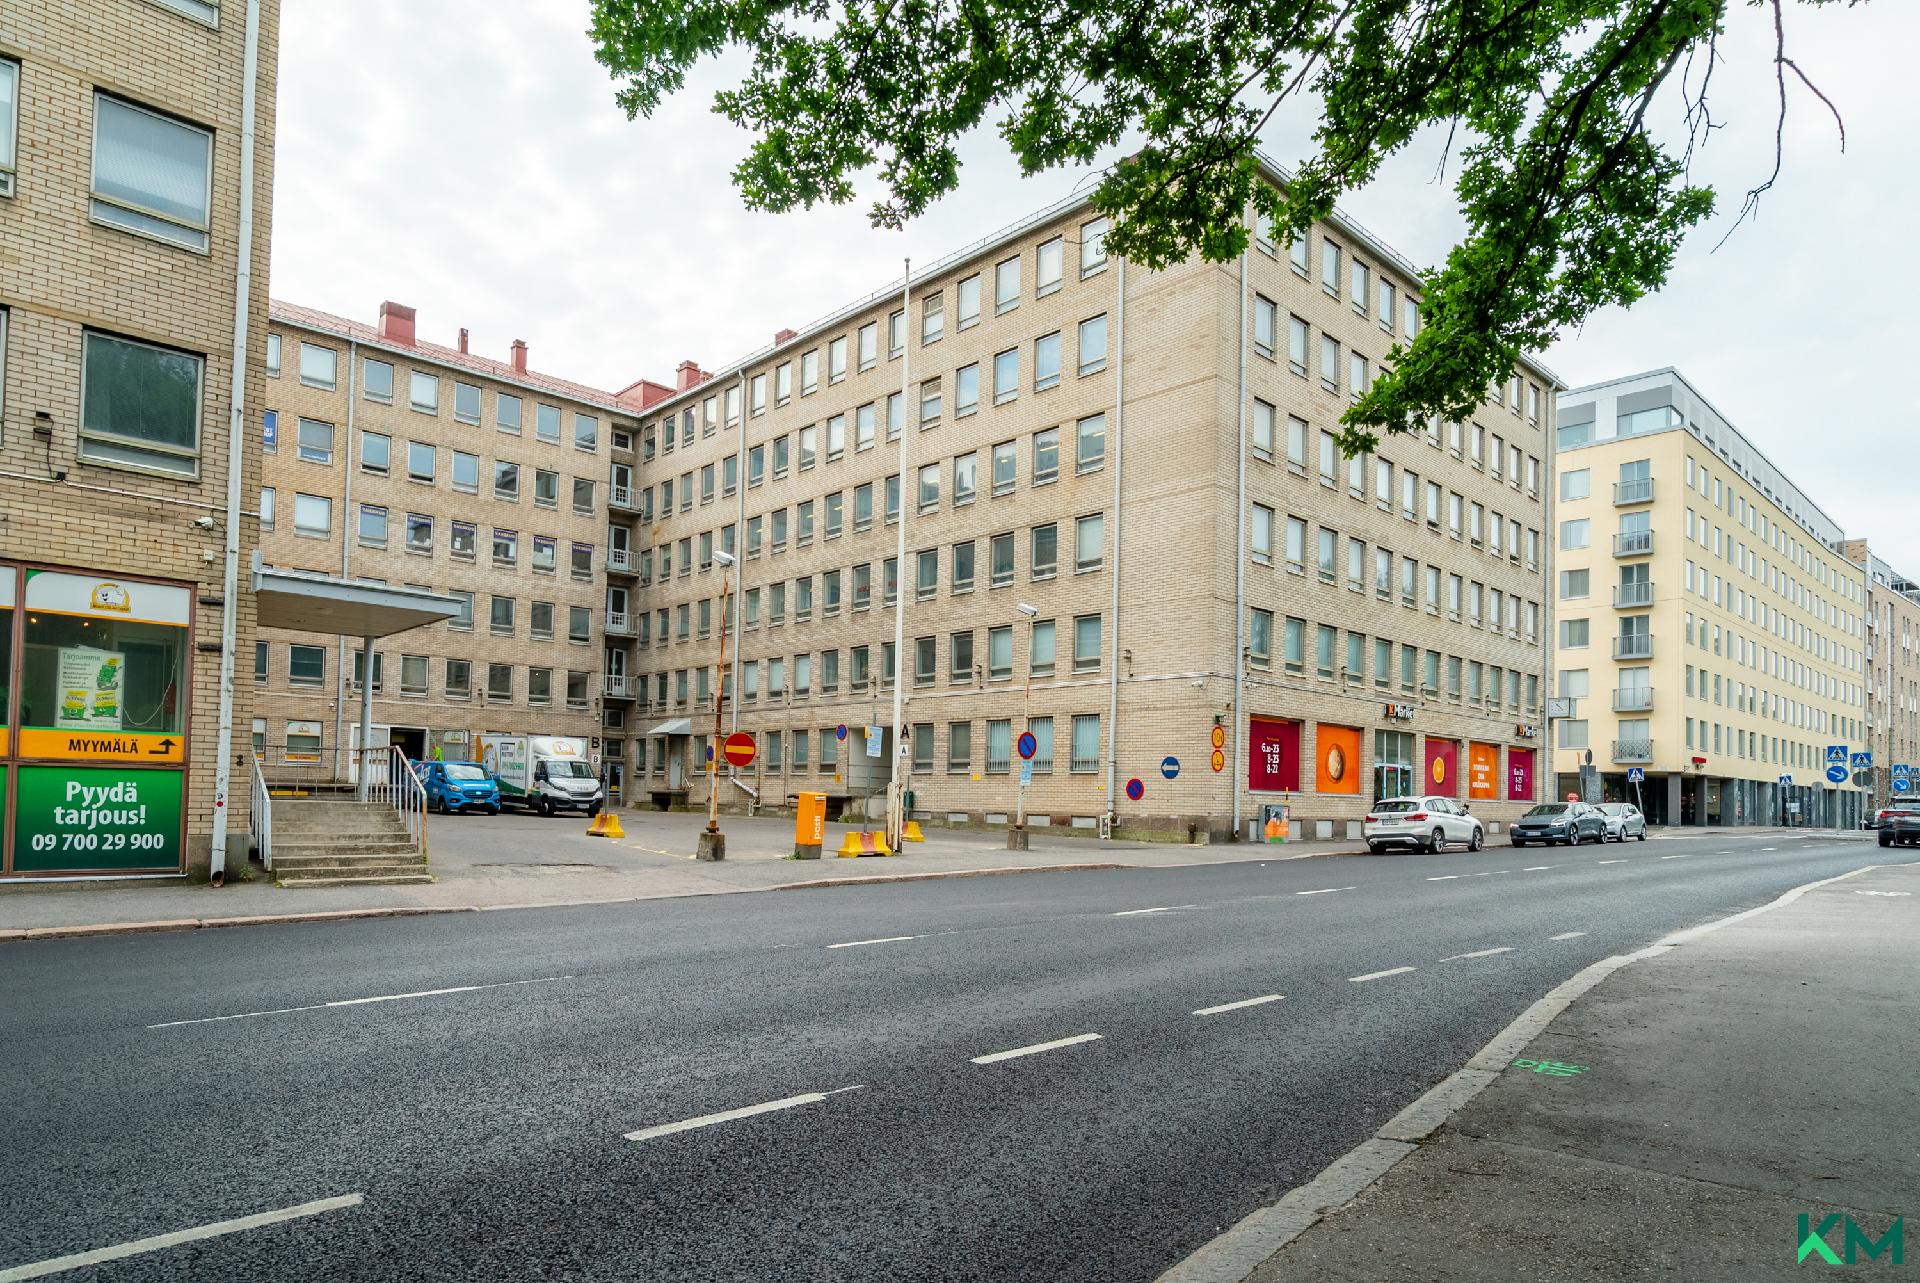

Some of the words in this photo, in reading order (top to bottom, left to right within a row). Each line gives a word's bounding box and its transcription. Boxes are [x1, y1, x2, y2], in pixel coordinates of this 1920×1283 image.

[901, 724, 910, 739] A
[68, 738, 139, 754] MYYMÄLÄ
[592, 736, 600, 748] B
[593, 755, 599, 763] B
[66, 781, 137, 808] Pyydä
[54, 804, 146, 830] tarjous!
[814, 815, 822, 840] posti
[31, 833, 57, 851] 09
[62, 833, 98, 851] 700
[101, 833, 126, 850] 29
[130, 833, 164, 850] 900
